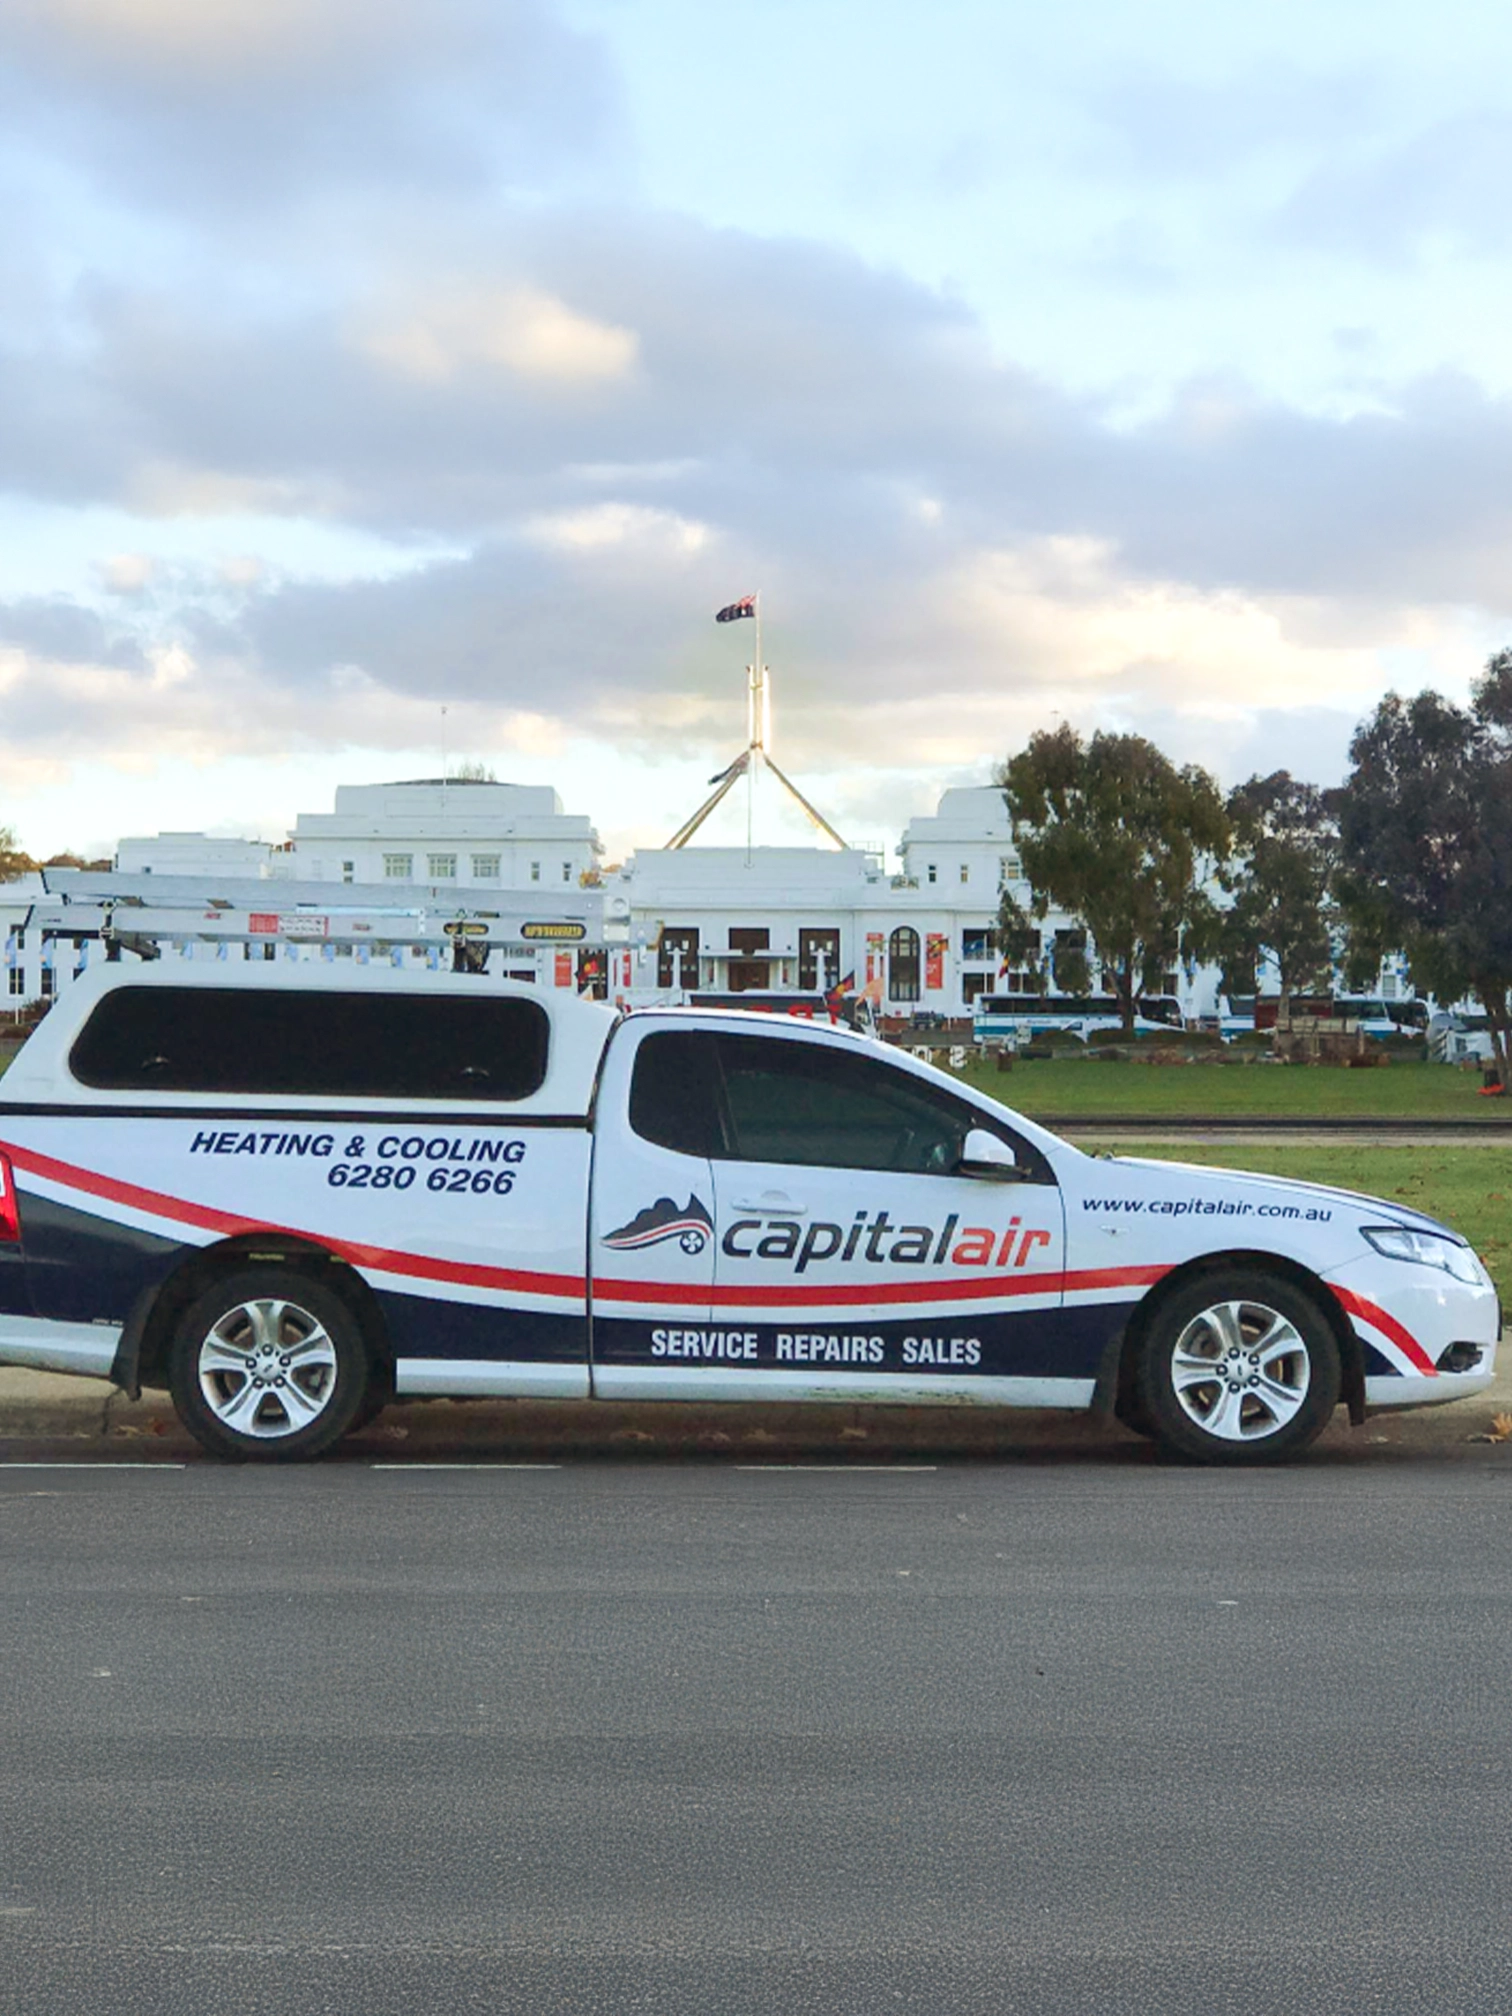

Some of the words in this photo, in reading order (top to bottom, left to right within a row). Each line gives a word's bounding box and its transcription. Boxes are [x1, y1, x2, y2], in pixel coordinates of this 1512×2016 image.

[189, 1131, 335, 1157] HEATING
[344, 1135, 366, 1158] &
[377, 1136, 527, 1164] COOLING
[327, 1163, 417, 1190] 6280
[426, 1167, 517, 1195] 6266
[1082, 1198, 1332, 1222] www.capitalair.com.au
[721, 1210, 1052, 1274] capitalair
[651, 1329, 758, 1359] SERVICE
[776, 1334, 884, 1362] REPAIRS
[903, 1337, 981, 1365] SALES
